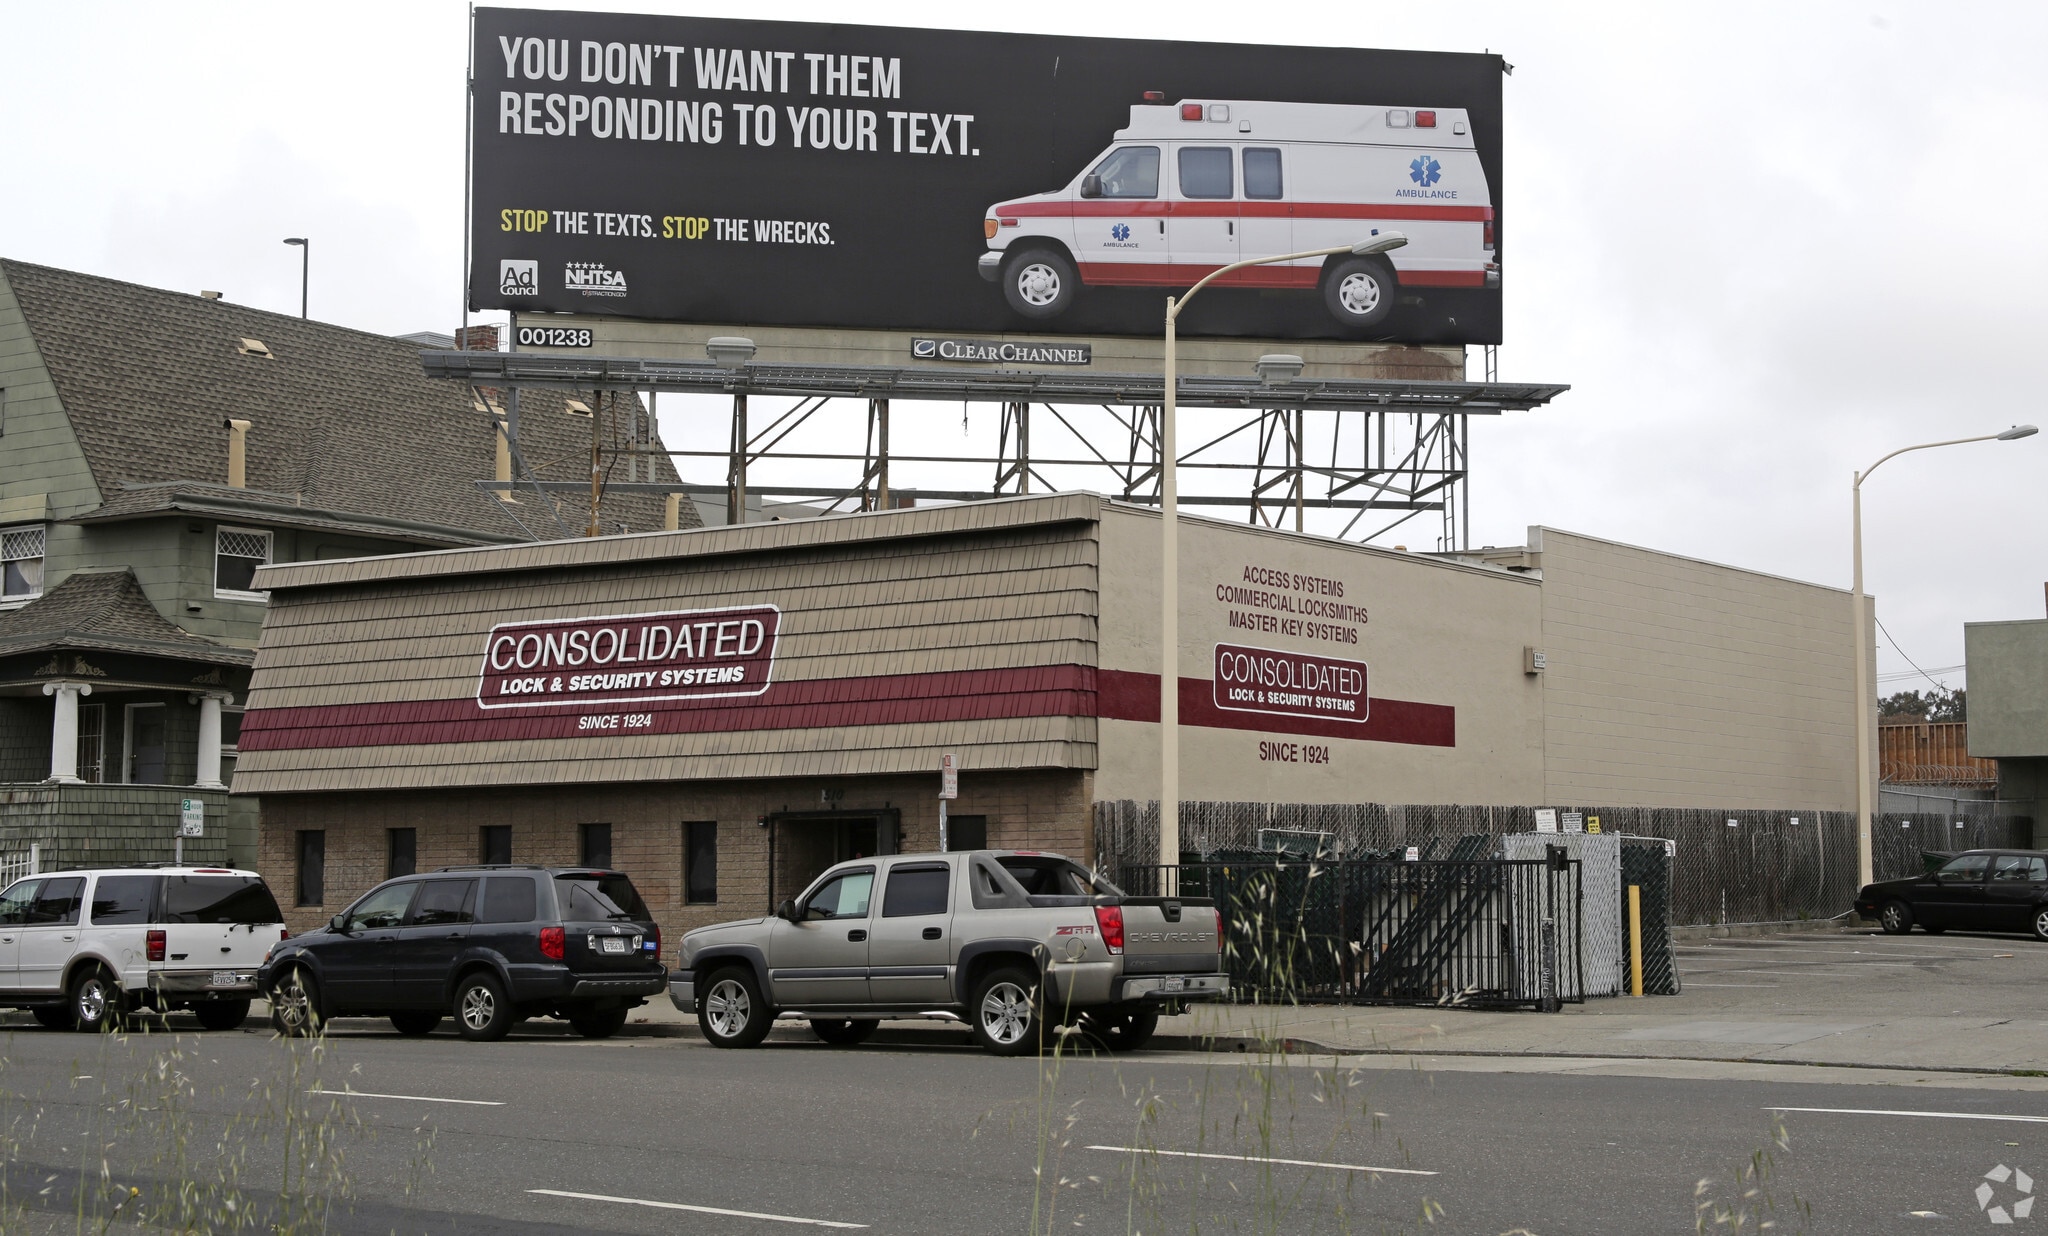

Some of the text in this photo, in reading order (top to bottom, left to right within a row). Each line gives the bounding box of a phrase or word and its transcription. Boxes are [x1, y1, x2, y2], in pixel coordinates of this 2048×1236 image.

[499, 36, 901, 99] YOU DON'T WANT THEM
[499, 91, 980, 156] RESPONDING TO YOUR TEXT.
[1395, 189, 1457, 199] AMBULANCE
[500, 208, 835, 246] STOP THE TEXTS. STOP THE WRECKS.
[502, 266, 533, 286] Ad
[565, 269, 627, 286] NHTSA
[500, 284, 538, 296] Council
[519, 328, 591, 347] 001238
[1243, 566, 1344, 598] ACCESS SYSTEMS
[1216, 584, 1368, 624] COMMERCIAL LOCKSMITHS
[1229, 610, 1358, 645] MASTER KEY SYSTEMS
[491, 619, 765, 671] CONSOLIDATED
[500, 666, 745, 695] LOCK & SECURITY SYSTEMS
[1220, 651, 1363, 696] CONSOLIDATED
[1229, 687, 1356, 713] LOCK & SECURITY SYSTEMS
[578, 713, 652, 730] SINCE 1924
[1259, 741, 1330, 765] SINCE 1924
[1129, 932, 1215, 943] CHEVROLET
